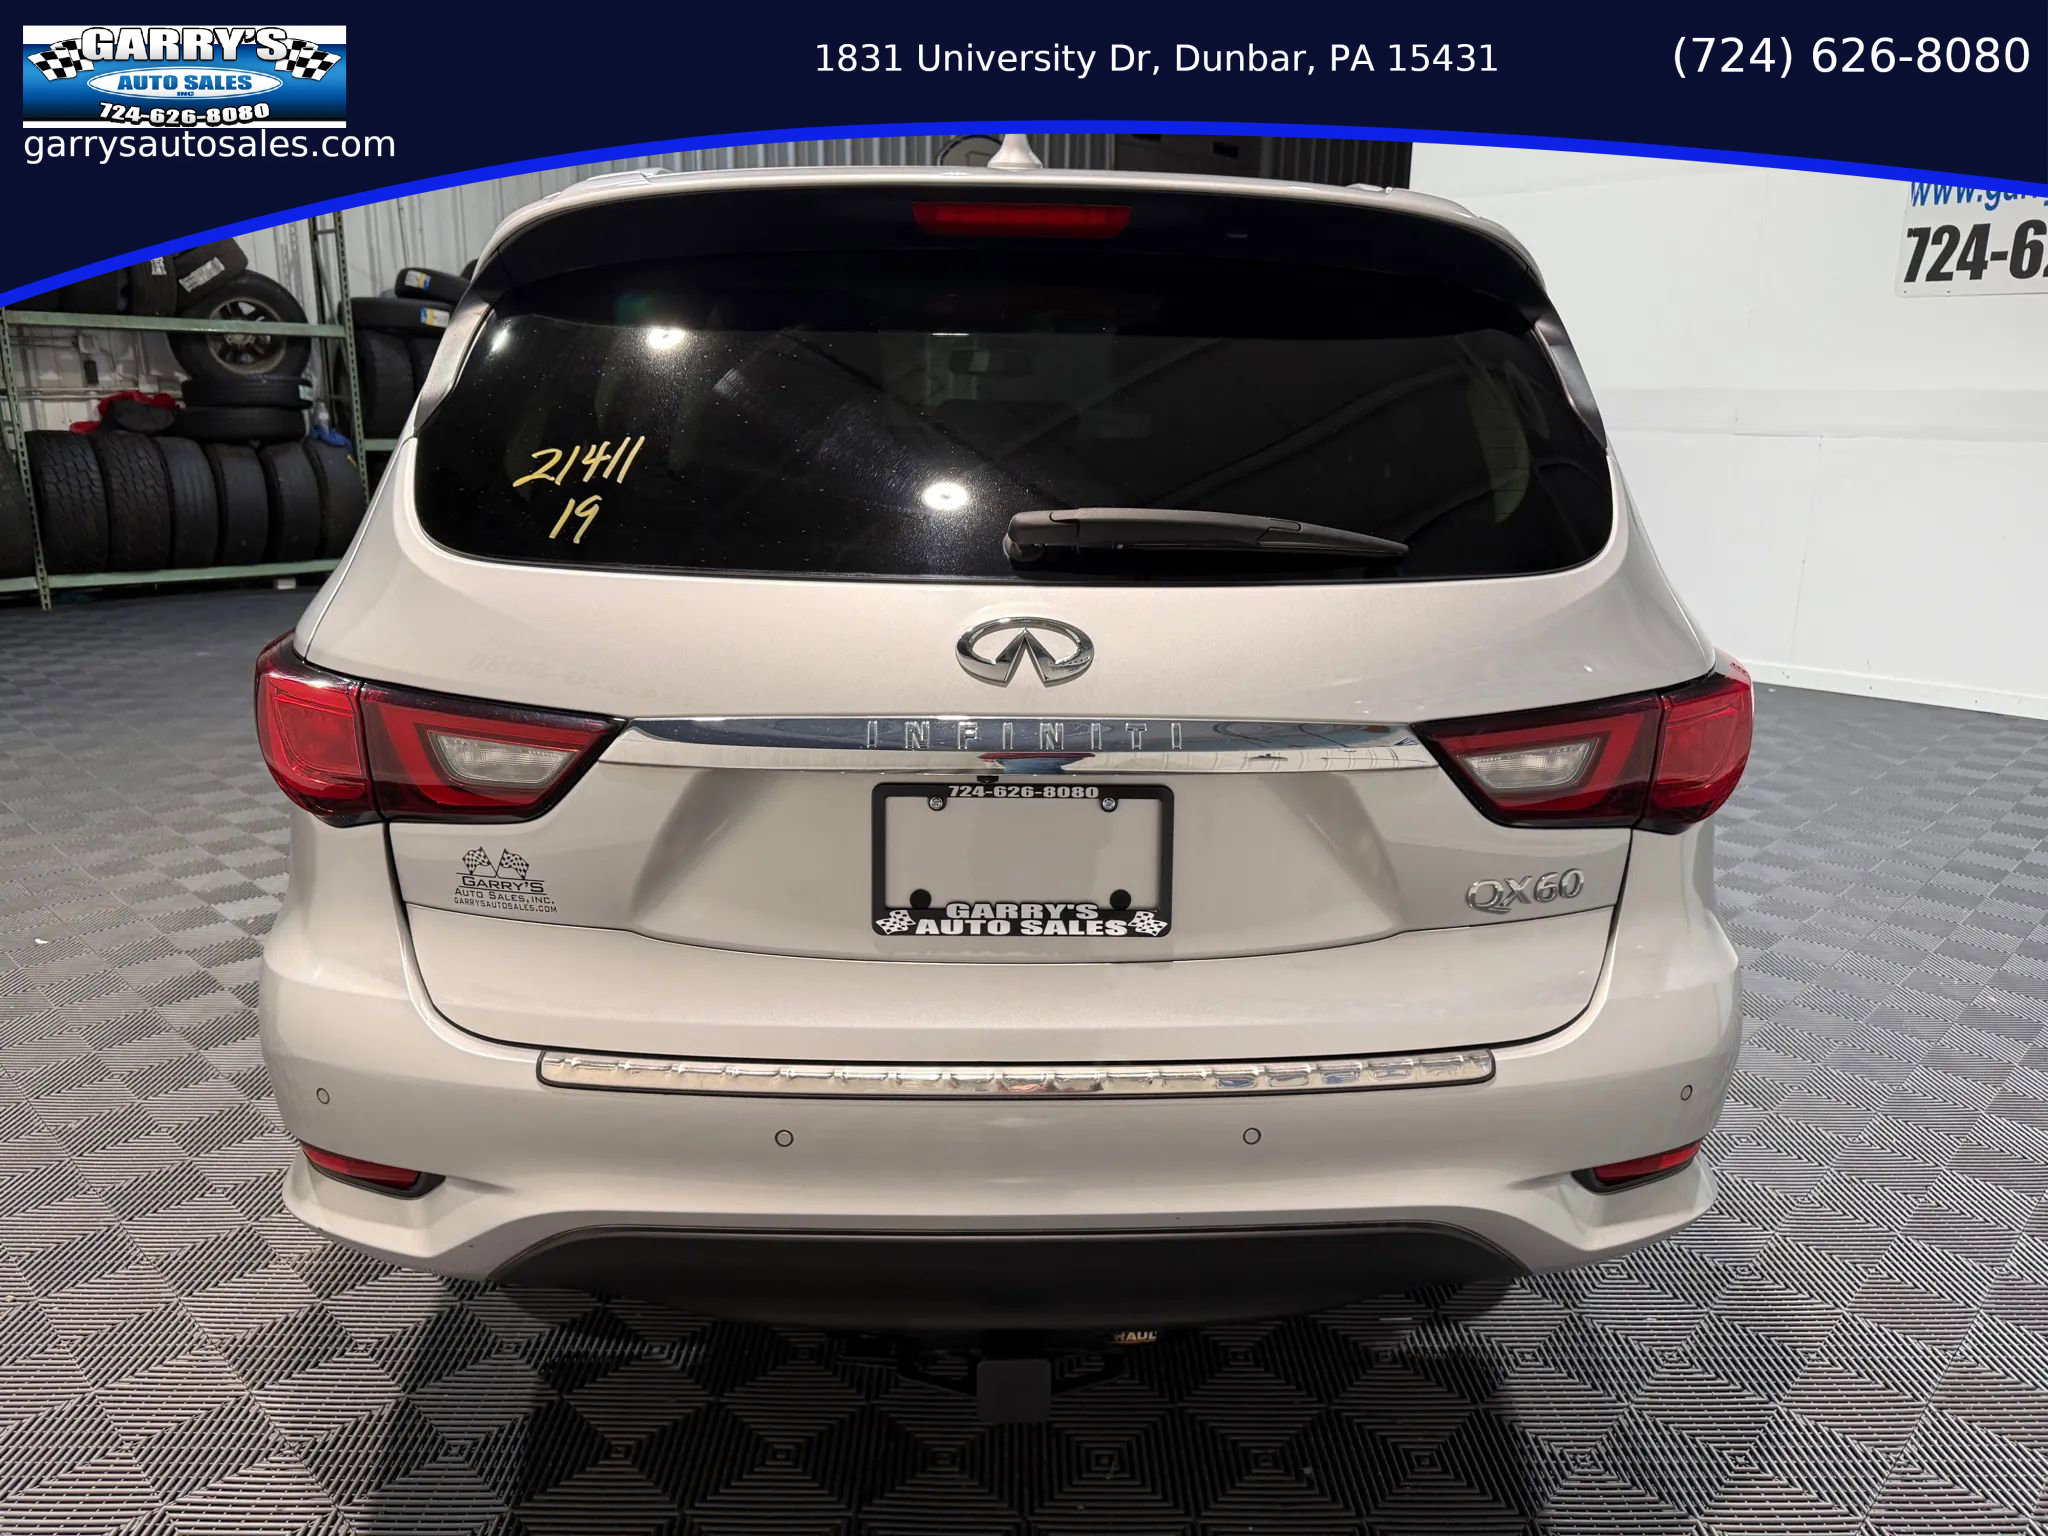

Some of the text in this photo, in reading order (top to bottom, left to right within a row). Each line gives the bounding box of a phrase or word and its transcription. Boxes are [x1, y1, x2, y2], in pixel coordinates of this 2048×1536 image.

[1903, 219, 2048, 283] 724-6
[512, 435, 646, 488] 21411
[548, 494, 603, 544] 19
[866, 720, 1183, 750] INFINITI
[948, 785, 1099, 799] 724-626-8080
[455, 888, 484, 898] AUTO
[462, 876, 544, 893] GARRY'S
[1466, 867, 1585, 914] QX60
[454, 897, 558, 913] GARRYSAUTOSALES.COM
[945, 902, 1099, 920] GARRY'S
[915, 919, 1129, 936] AUTO SALES
